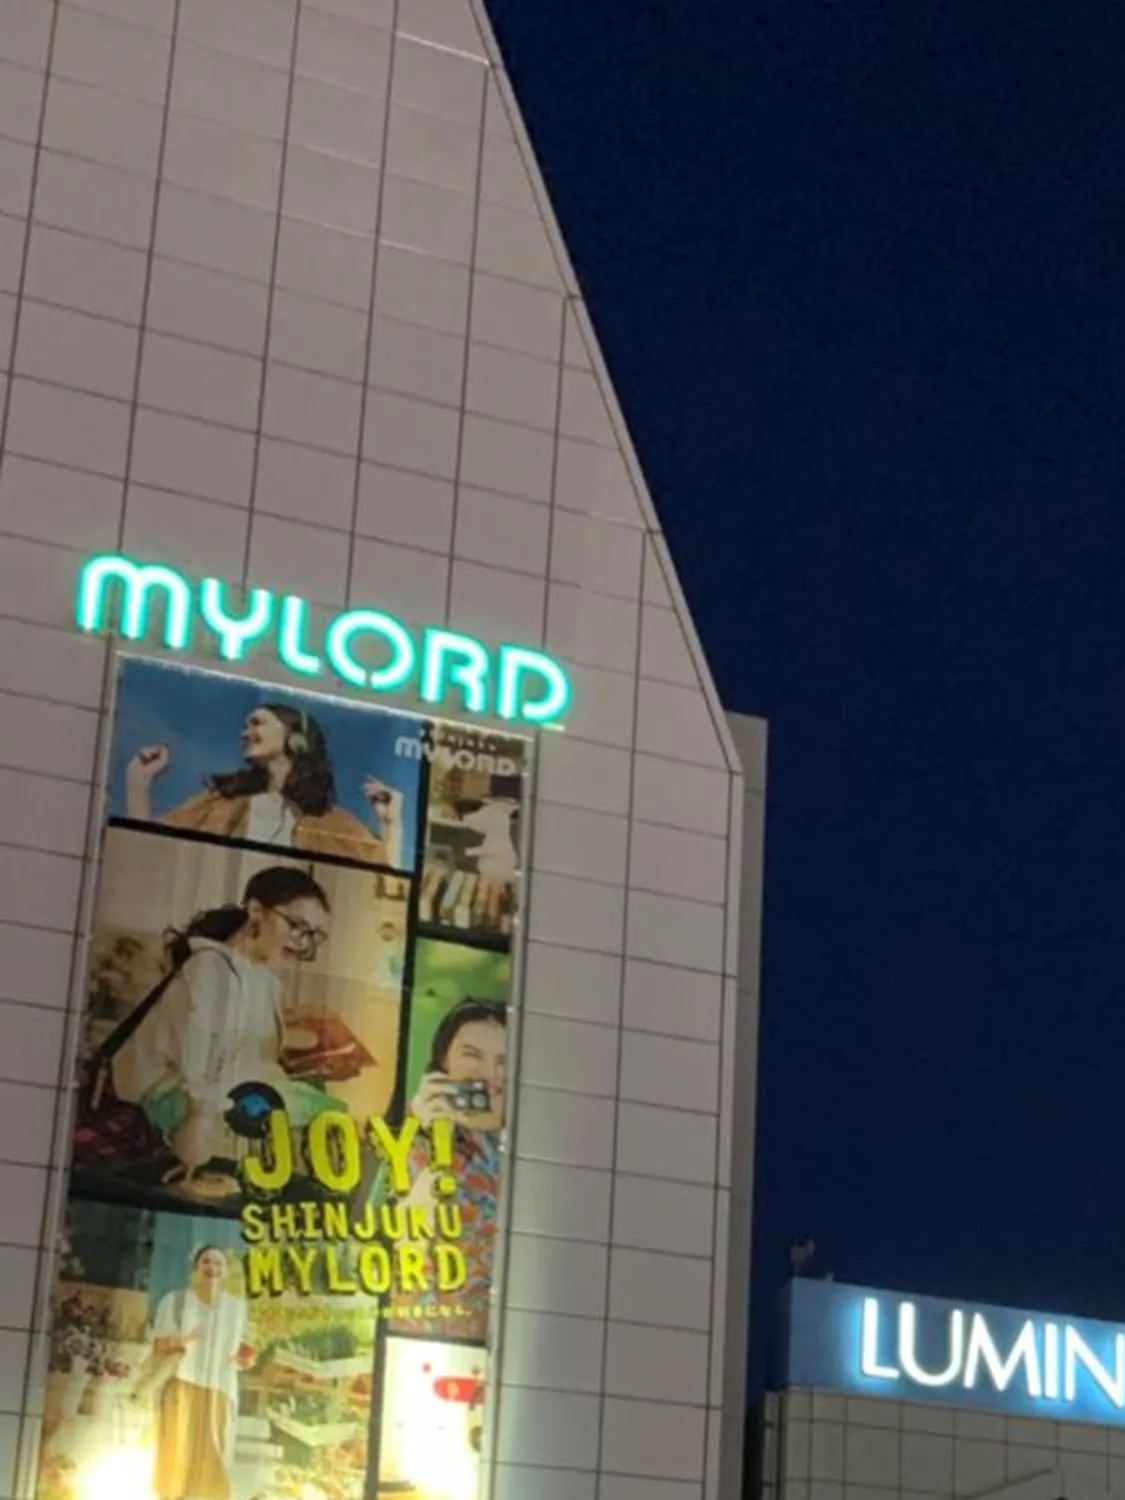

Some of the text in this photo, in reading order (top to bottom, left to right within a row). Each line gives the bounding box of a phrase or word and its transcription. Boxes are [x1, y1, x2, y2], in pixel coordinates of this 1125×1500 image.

[77, 553, 571, 722] MYLORD
[244, 1110, 457, 1193] JOY!
[242, 1202, 462, 1240] SHINJUKU
[249, 1245, 467, 1294] MYLORD
